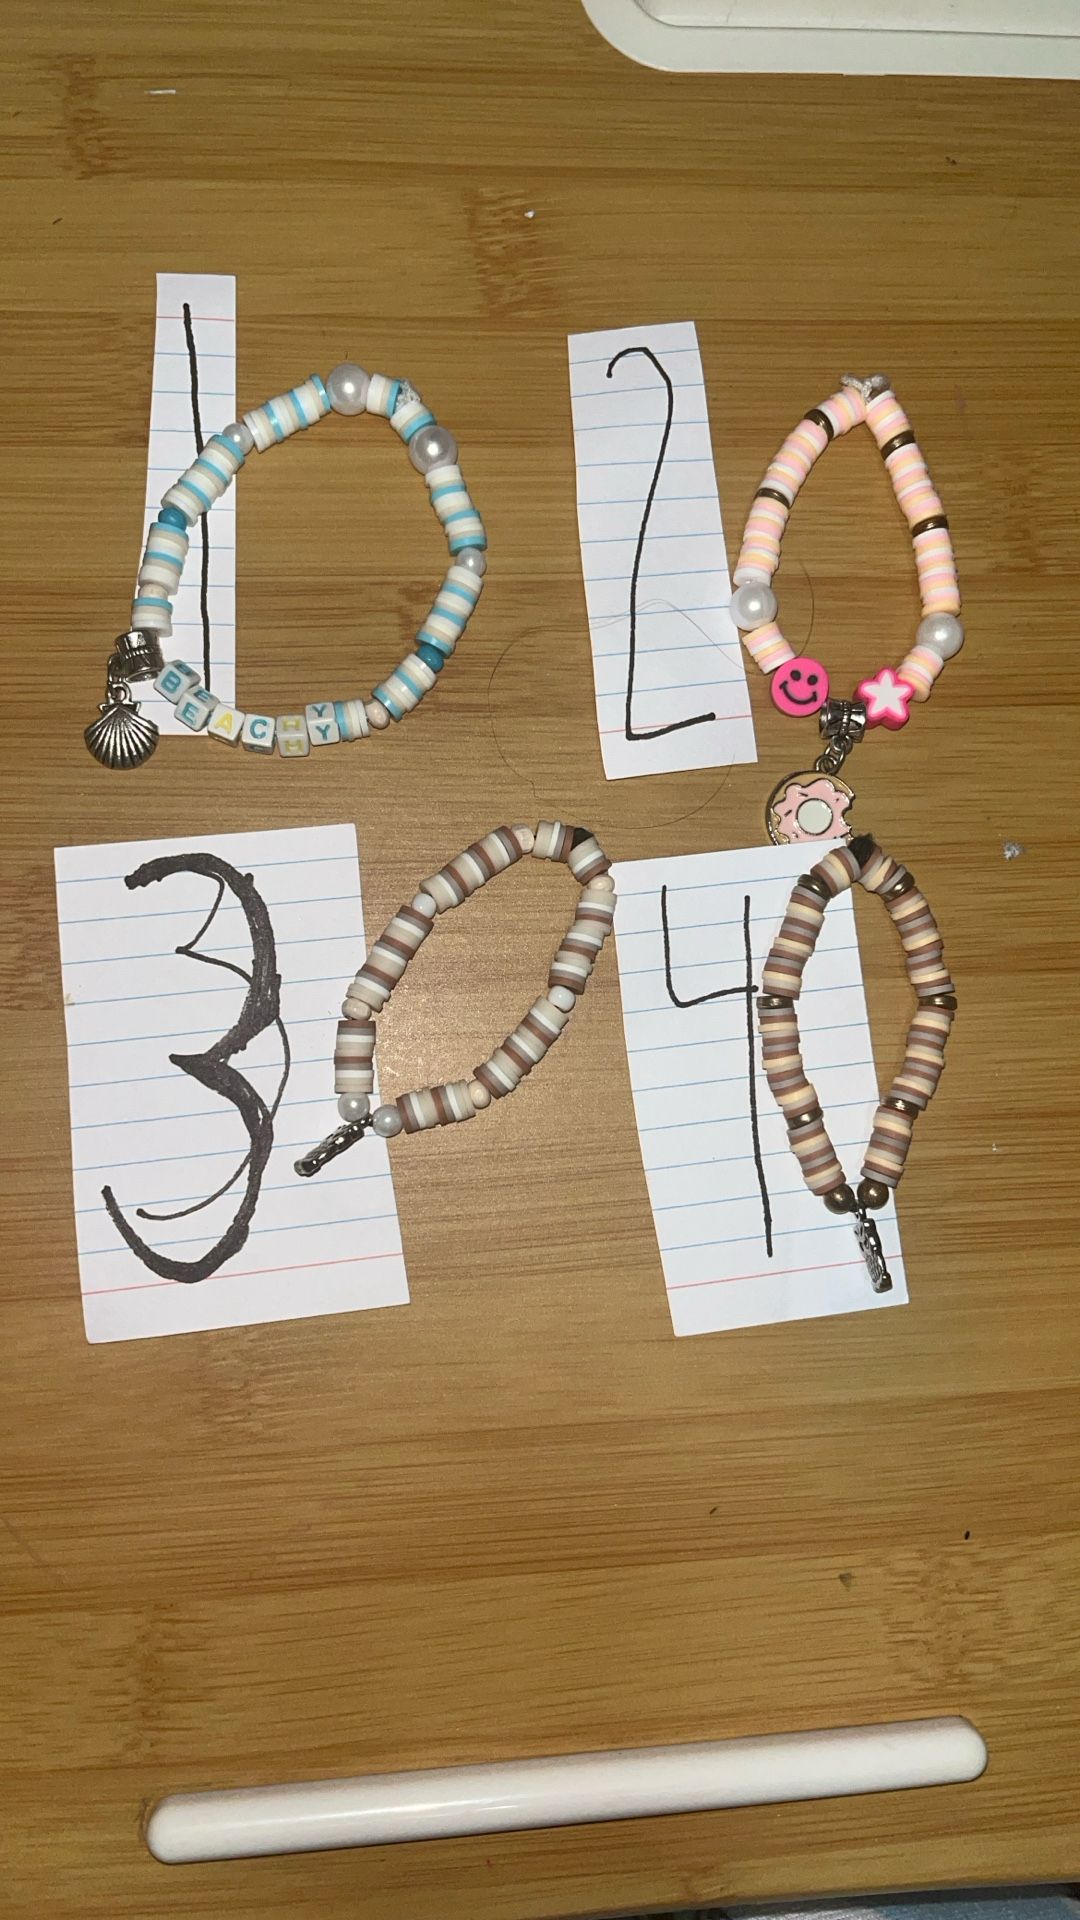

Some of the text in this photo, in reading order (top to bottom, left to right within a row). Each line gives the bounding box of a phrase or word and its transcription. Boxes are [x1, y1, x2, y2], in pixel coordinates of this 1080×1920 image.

[183, 302, 212, 691] 1
[606, 346, 716, 741] 2
[101, 852, 291, 1284] 3
[661, 884, 773, 1258] 4
